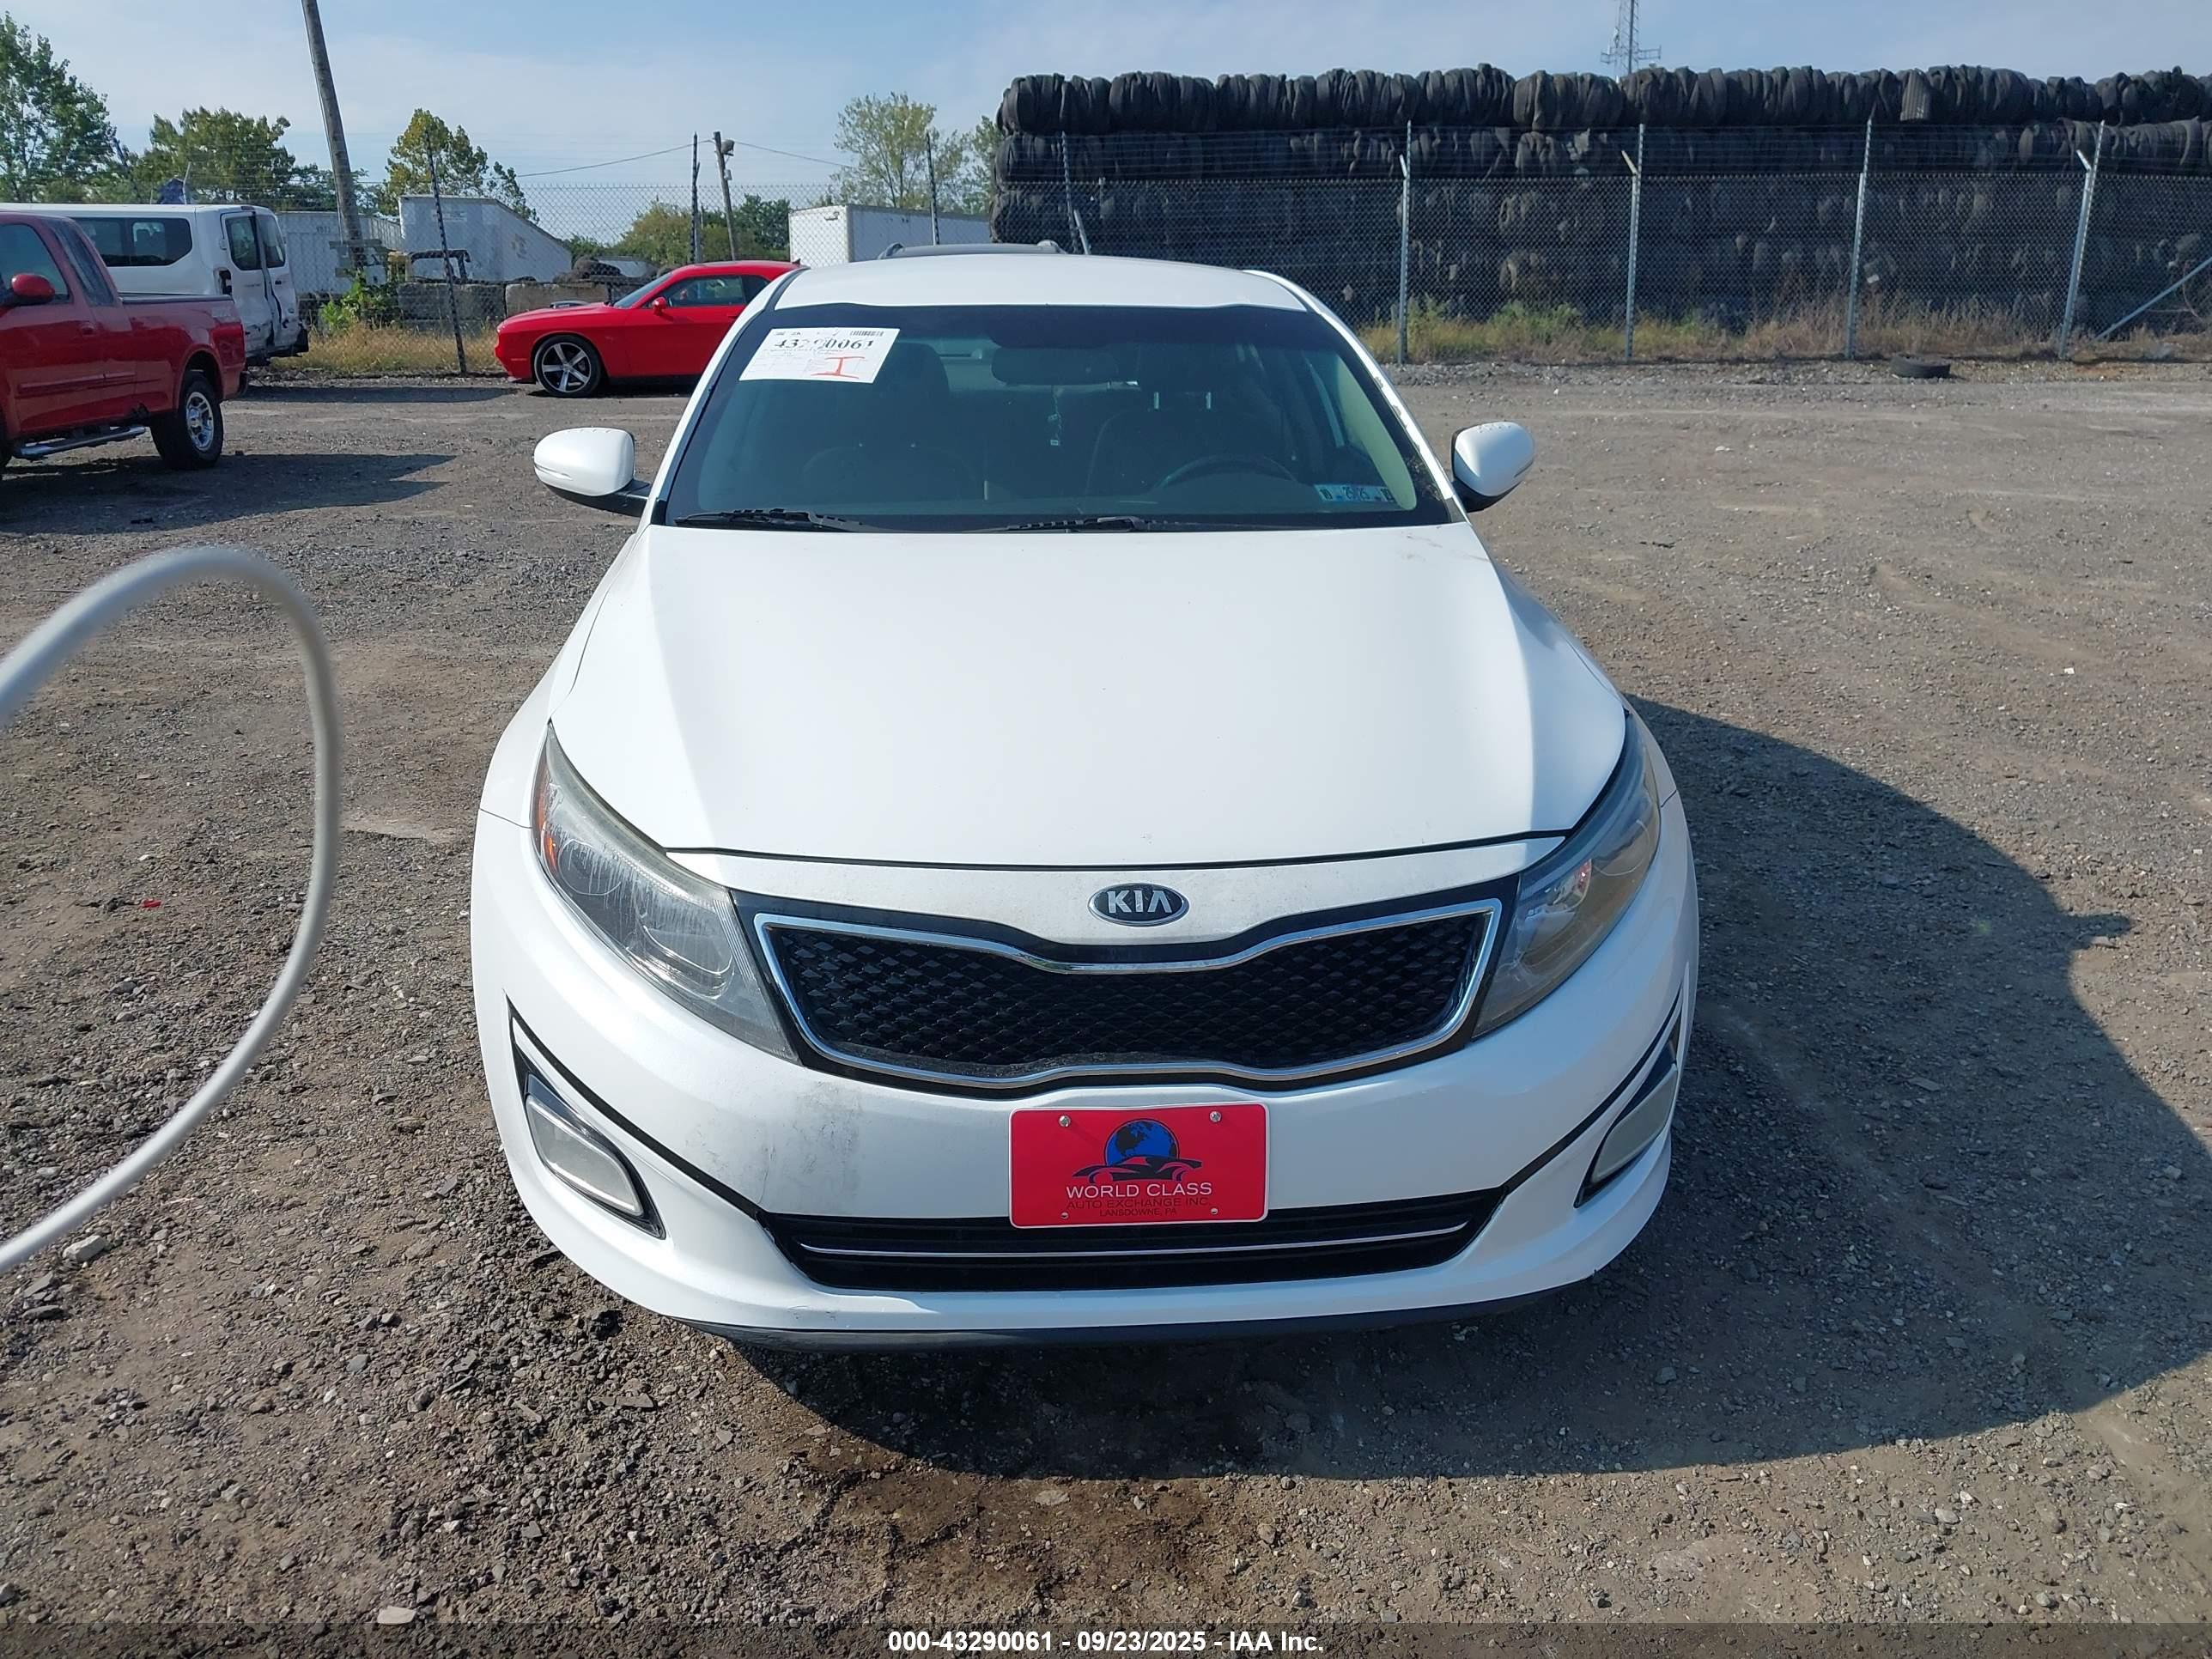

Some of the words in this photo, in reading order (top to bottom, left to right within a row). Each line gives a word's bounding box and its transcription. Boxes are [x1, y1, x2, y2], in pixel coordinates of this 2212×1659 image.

[1106, 890, 1173, 914] KIA
[1066, 1185, 1139, 1199] WORLD
[1146, 1182, 1212, 1197] CLASS
[1066, 1200, 1103, 1210] AUTO
[1107, 1197, 1182, 1209] EXCHANGE
[1164, 1206, 1178, 1216] PA
